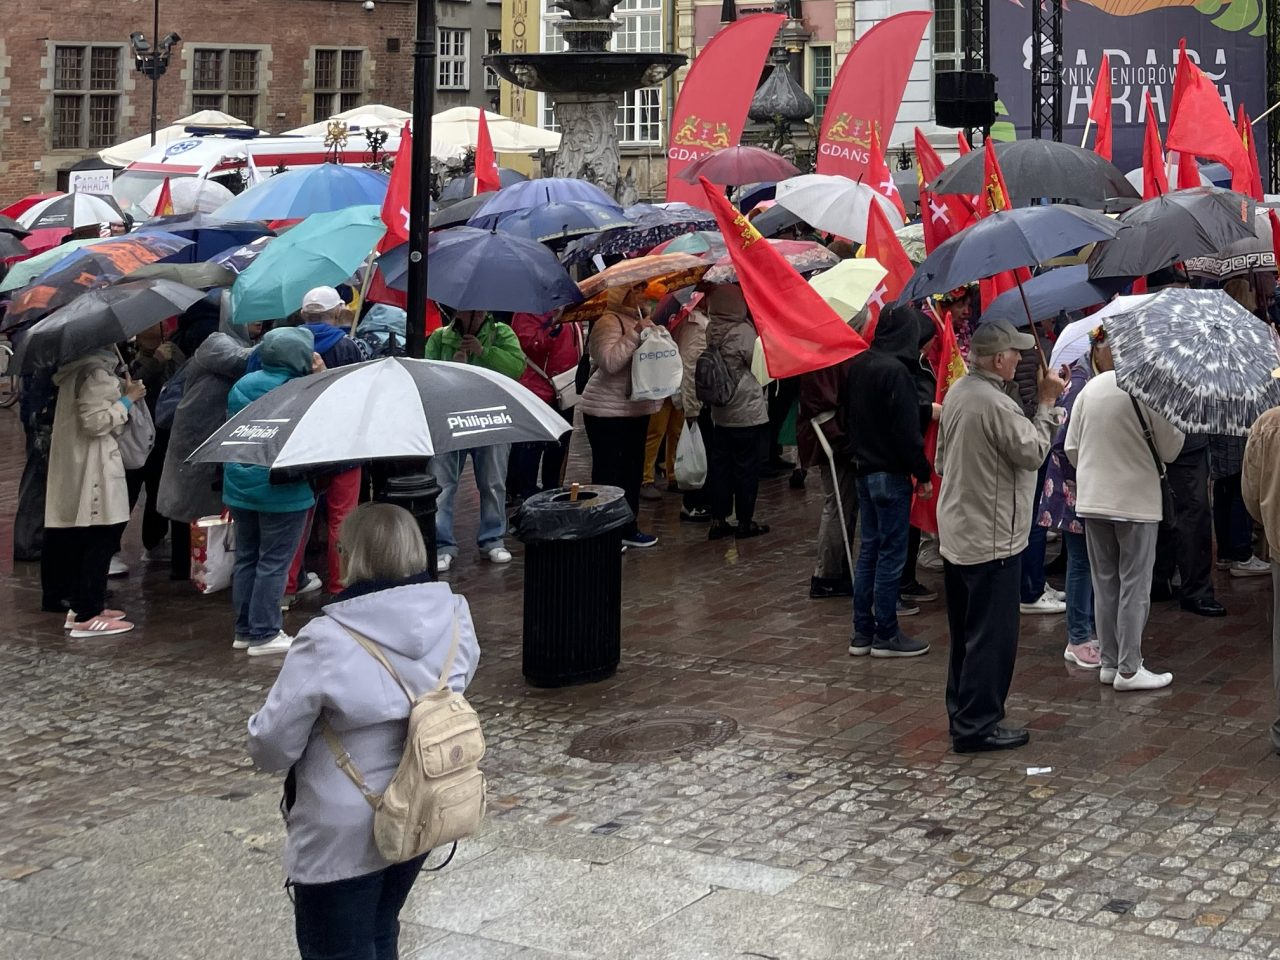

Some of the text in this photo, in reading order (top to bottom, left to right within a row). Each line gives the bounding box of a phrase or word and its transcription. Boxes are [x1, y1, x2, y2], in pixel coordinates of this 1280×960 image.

[1111, 64, 1178, 85] ENIORÓW
[820, 143, 870, 165] GDAŃS
[640, 349, 677, 361] pepco
[447, 412, 512, 429] Philipiak
